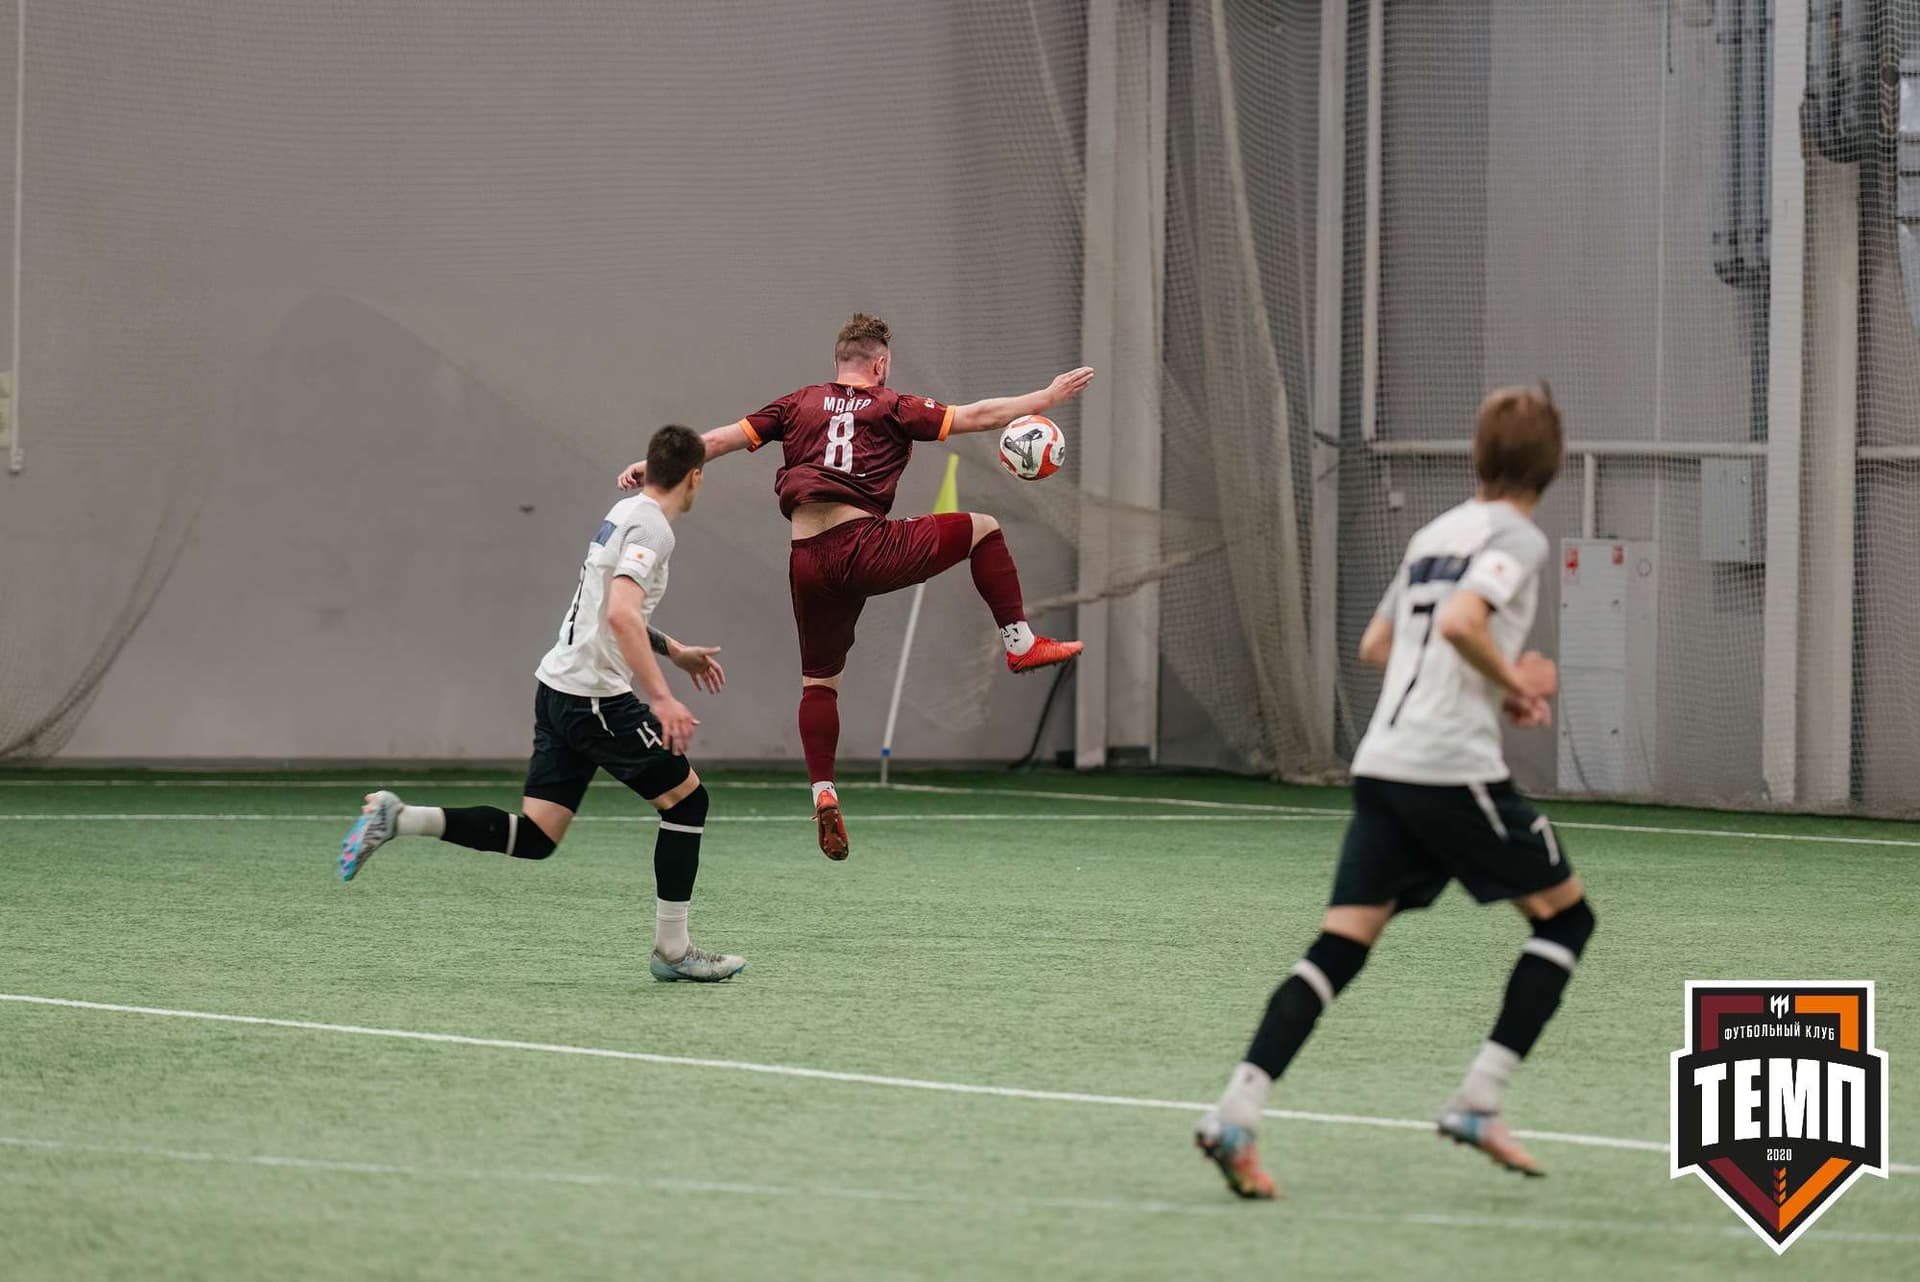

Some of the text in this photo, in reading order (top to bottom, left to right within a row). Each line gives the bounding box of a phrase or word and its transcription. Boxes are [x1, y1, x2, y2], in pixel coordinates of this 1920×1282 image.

[823, 411, 855, 475] 8
[1388, 601, 1436, 727] 7
[636, 721, 664, 749] 4
